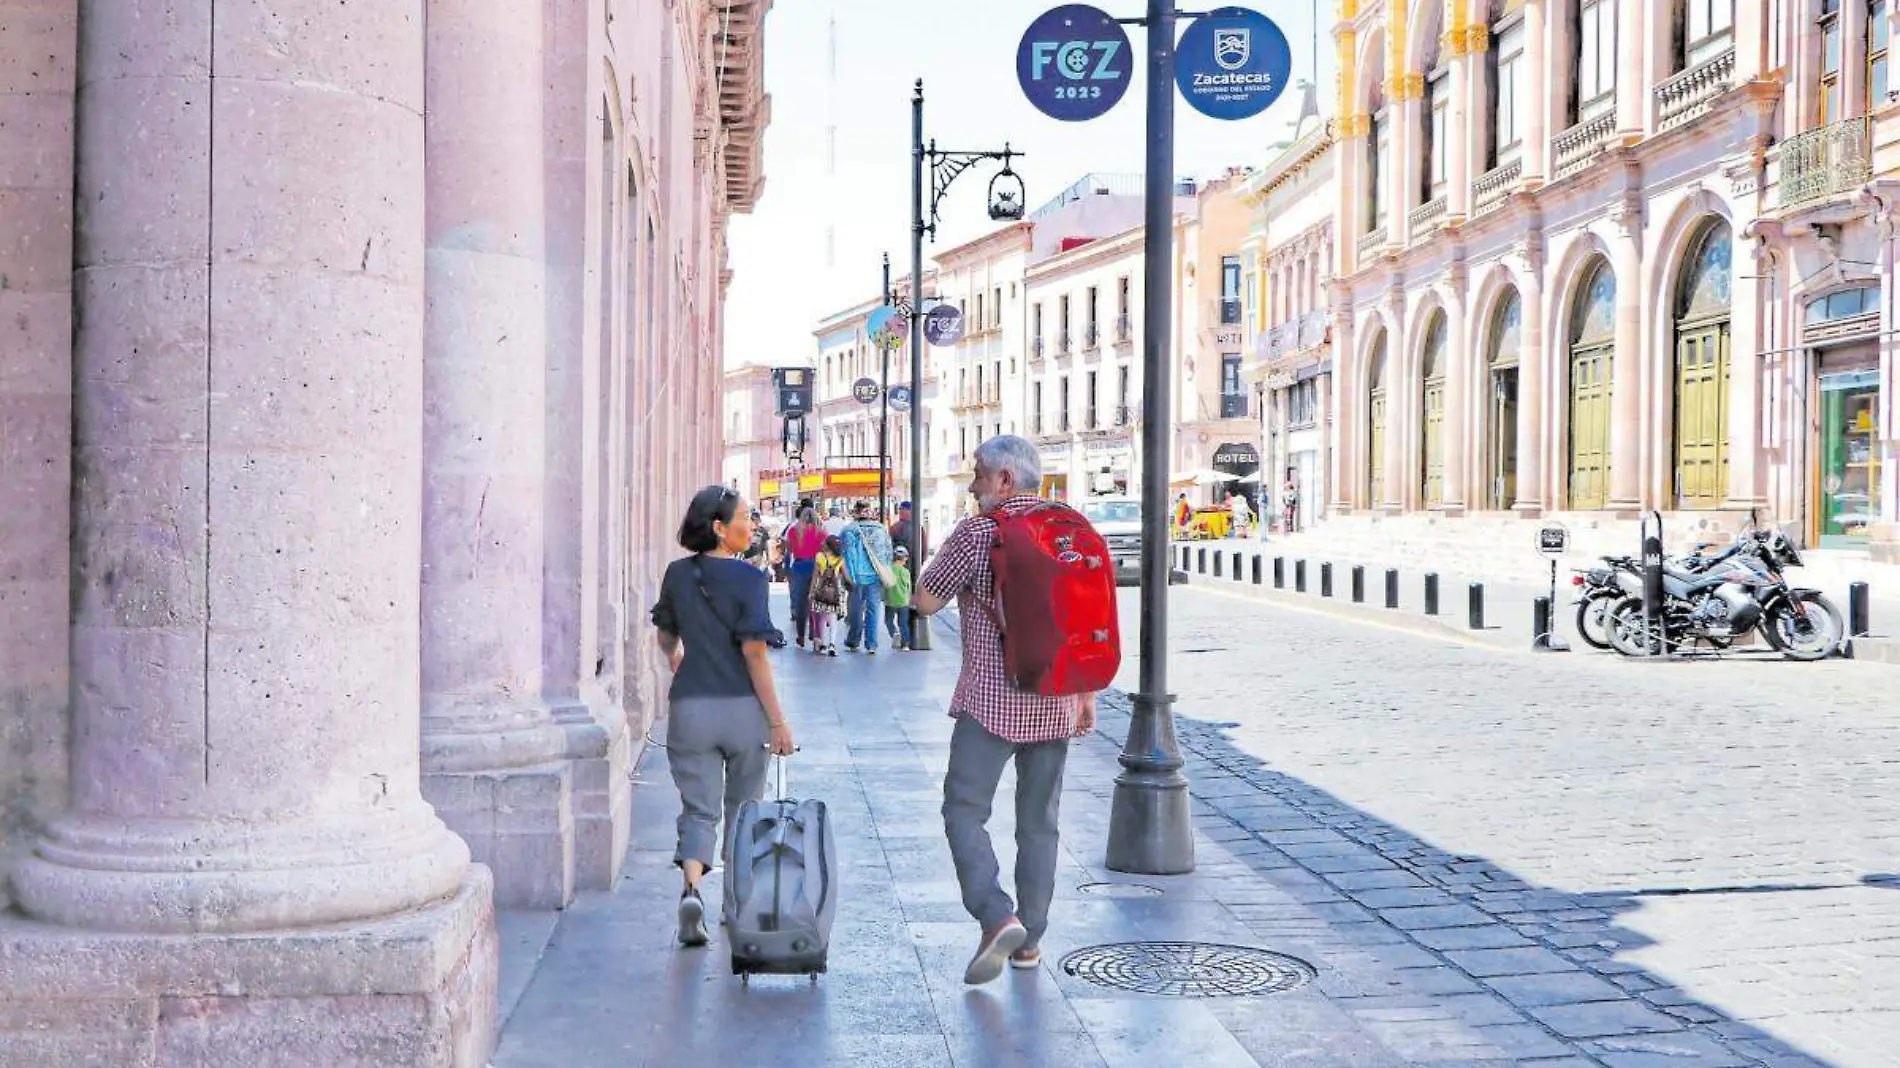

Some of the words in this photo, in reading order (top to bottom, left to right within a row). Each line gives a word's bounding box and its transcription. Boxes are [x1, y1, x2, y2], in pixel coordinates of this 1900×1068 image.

[1032, 41, 1122, 80] FCZ
[1193, 73, 1271, 85] Zacatecas
[1055, 86, 1101, 99] 2023
[1216, 453, 1255, 464] HOTEL
